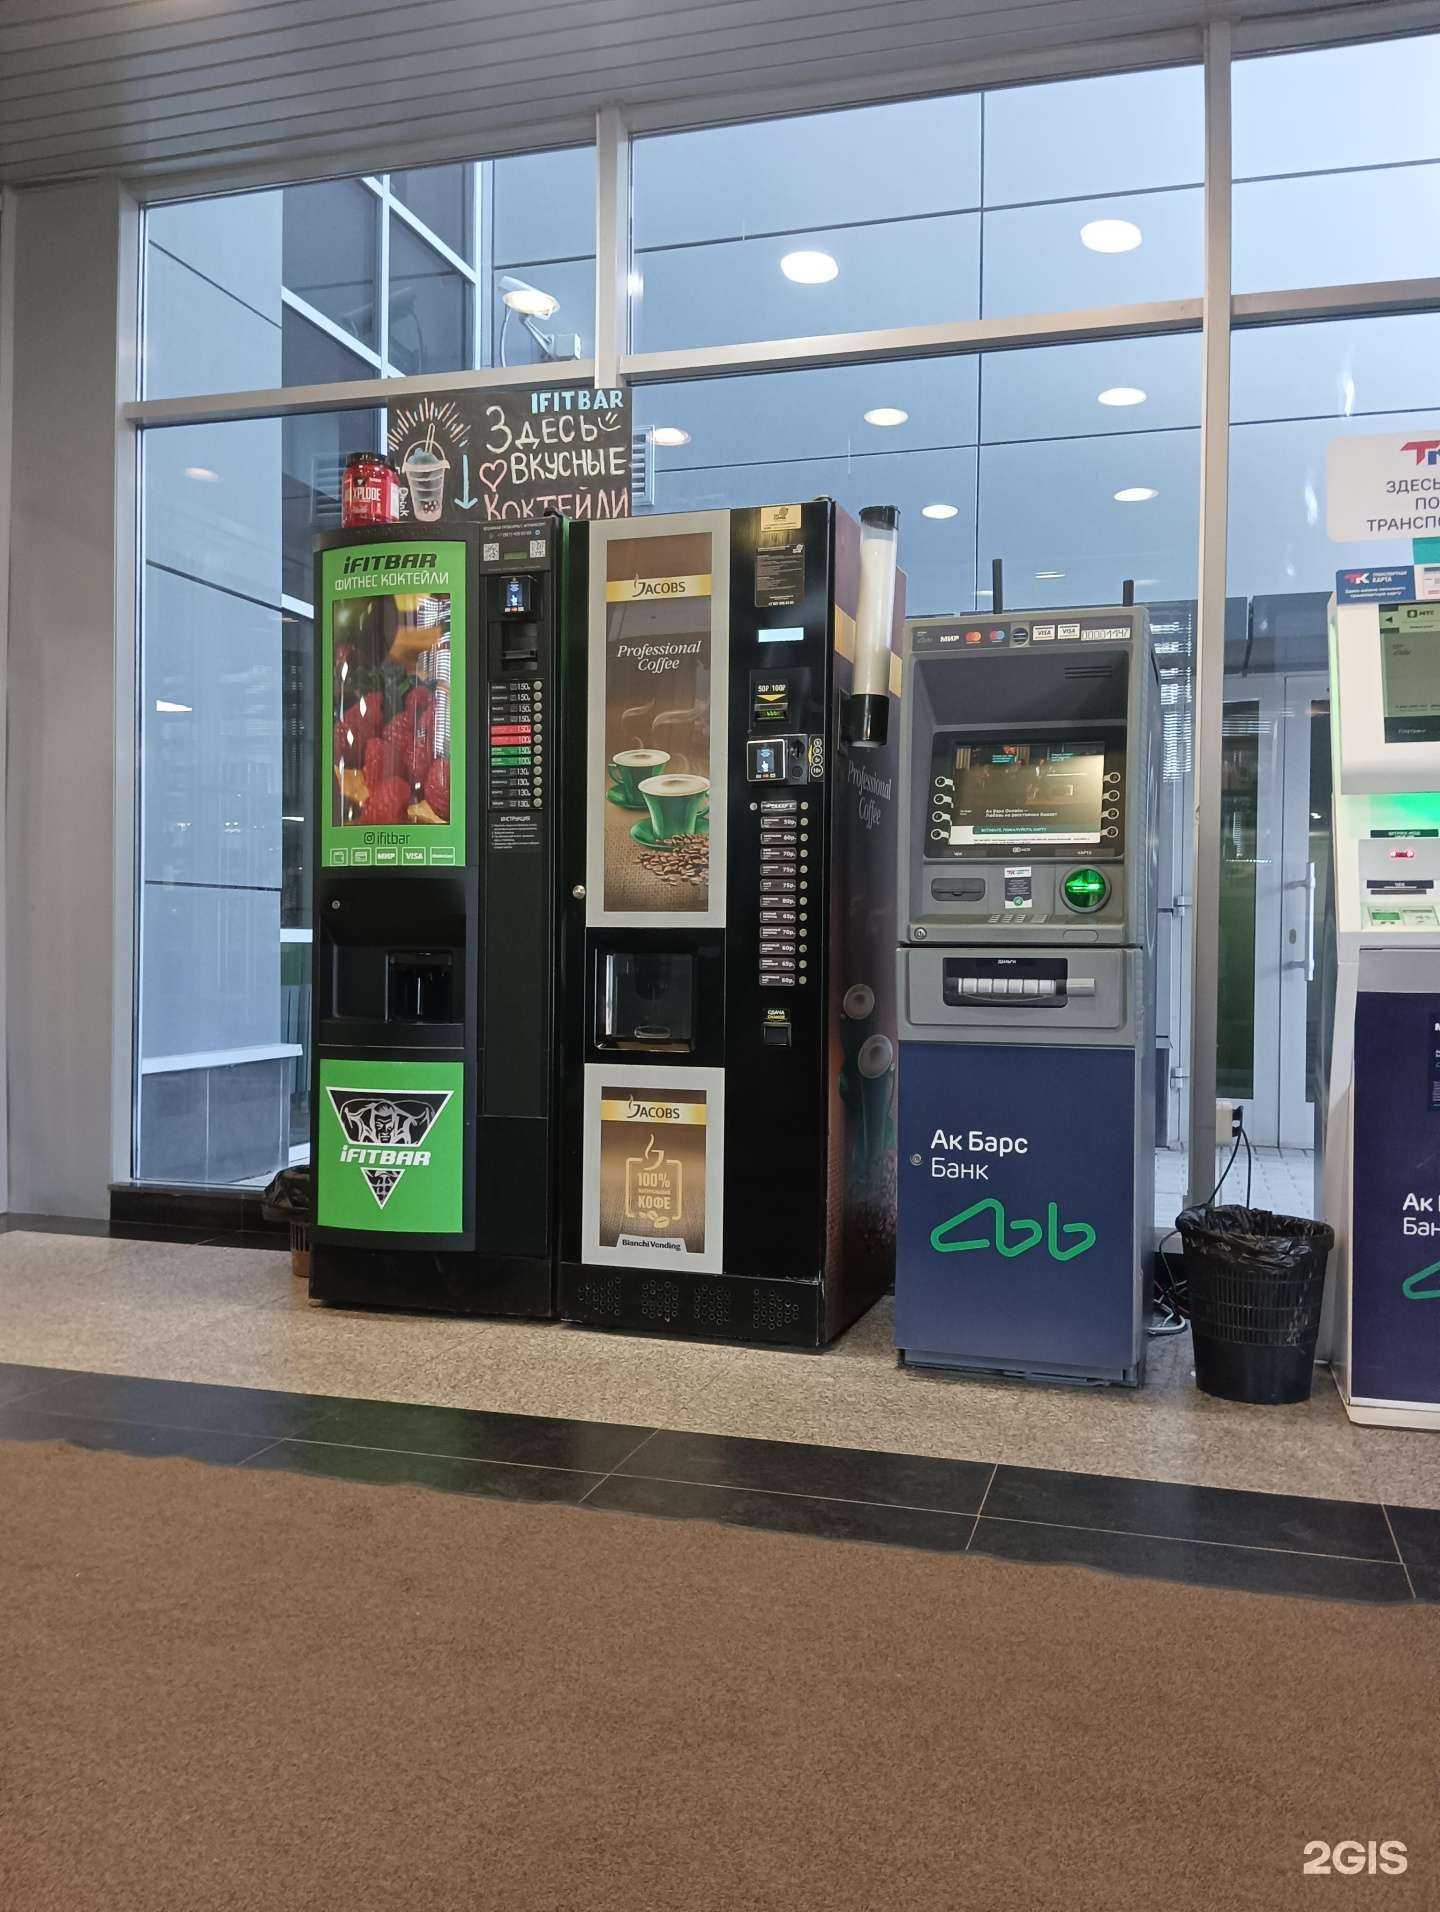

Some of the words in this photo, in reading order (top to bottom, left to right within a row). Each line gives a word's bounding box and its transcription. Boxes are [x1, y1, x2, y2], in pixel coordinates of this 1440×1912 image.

[531, 390, 623, 414] IFITBAR
[486, 405, 598, 454] ЗДЕСЬ
[510, 446, 627, 484] ВКУСНЫЕ
[484, 487, 629, 520] КОКТЕЙЛИ
[1367, 515, 1440, 532] ТРАНСП
[343, 553, 437, 574] iFITBAR
[335, 574, 378, 590] ФИТНЕС
[381, 570, 449, 586] КОКТЕЙЛИ
[632, 582, 686, 598] JACOBS
[617, 641, 702, 660] Professional
[638, 657, 680, 673] Coffee
[848, 760, 892, 800] Professional
[859, 797, 880, 830] Coffee
[377, 832, 410, 844] ifitbar
[406, 852, 423, 860] VISA
[627, 1103, 680, 1119] JACOBS
[931, 1129, 963, 1150] Ак
[968, 1131, 1029, 1157] Барс
[340, 1145, 431, 1166] iFITBAR
[931, 1157, 989, 1180] Банк
[637, 1172, 670, 1188] 100%
[638, 1195, 671, 1209] КОФЕ
[1403, 1193, 1433, 1211] Ак
[622, 1239, 649, 1248] Bianchi
[650, 1240, 681, 1251] Vending
